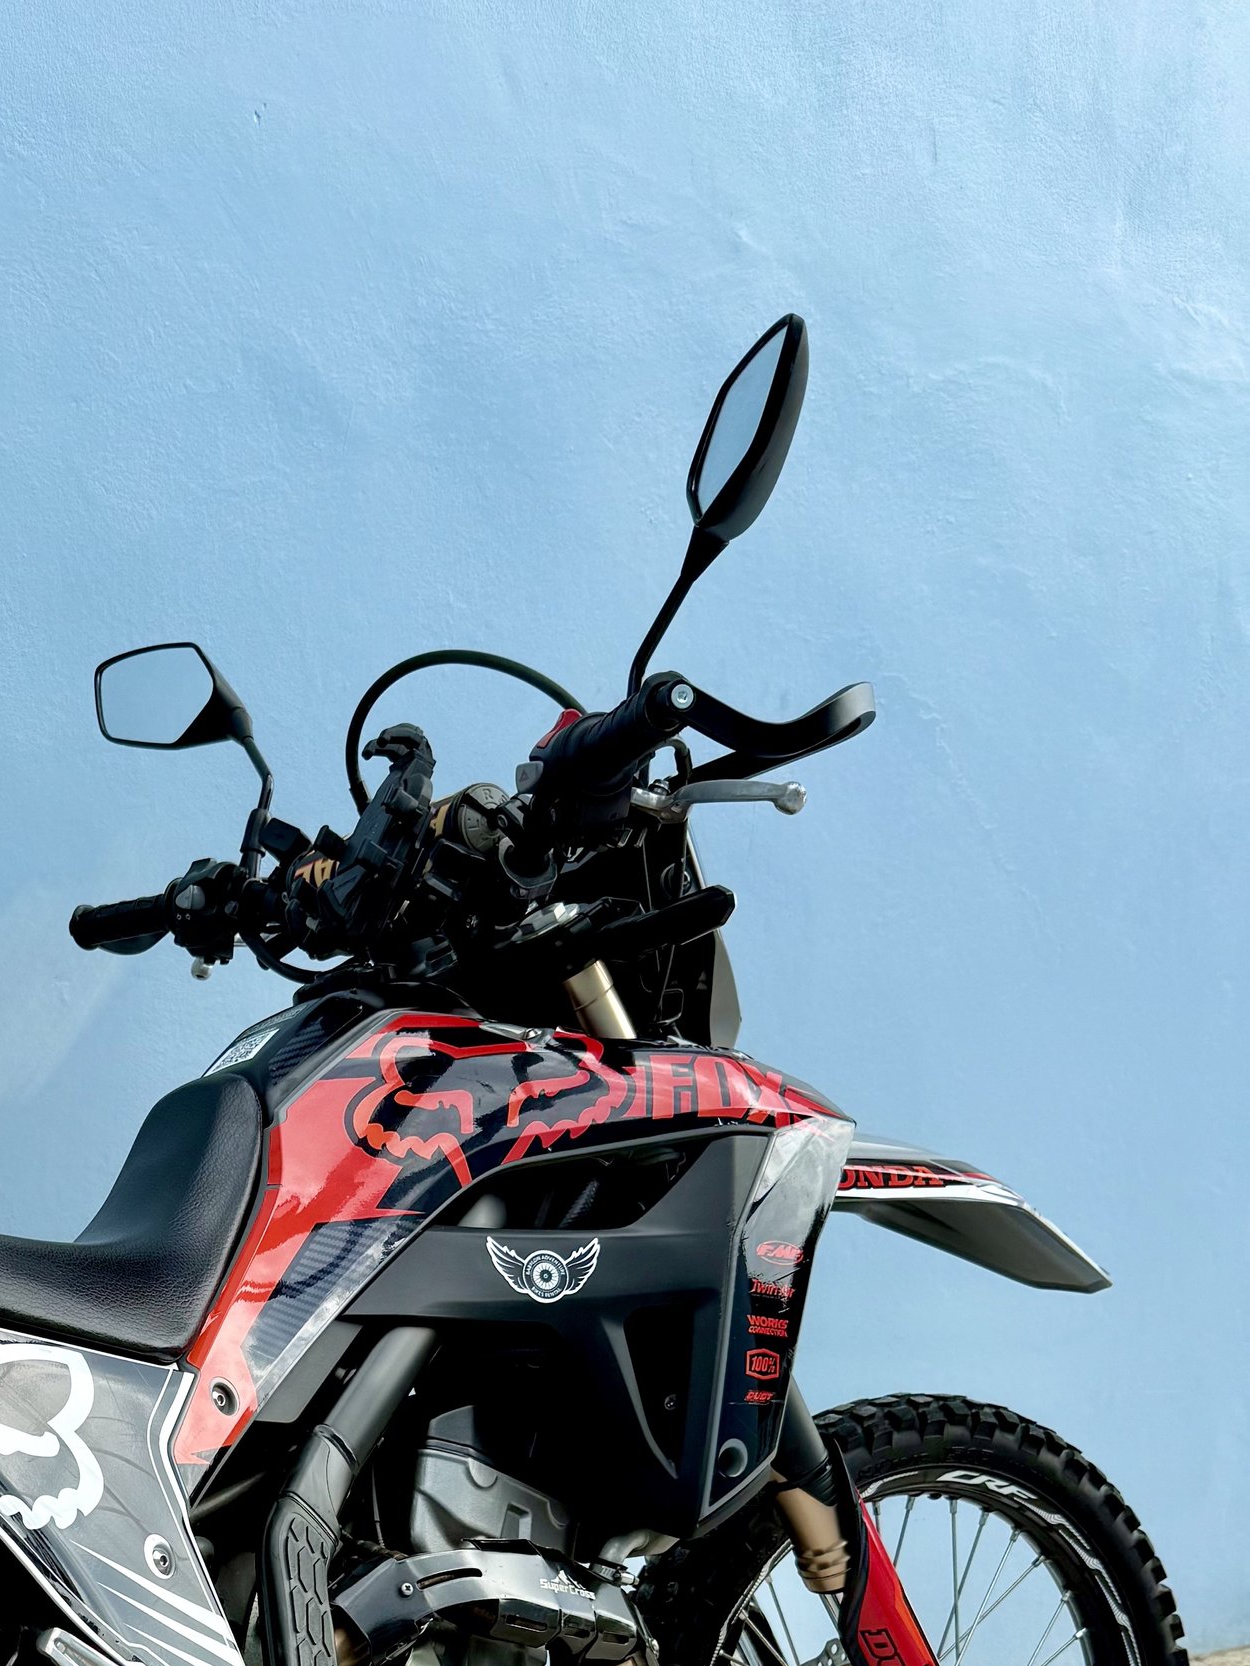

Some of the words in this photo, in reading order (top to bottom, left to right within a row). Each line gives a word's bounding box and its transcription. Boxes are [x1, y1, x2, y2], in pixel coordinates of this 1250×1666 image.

[838, 1164, 946, 1190] ONDA
[746, 1314, 789, 1330] WORKS
[748, 1325, 788, 1338] CONNECTION
[751, 1355, 776, 1373] 100%
[936, 1469, 1038, 1500] CRF
